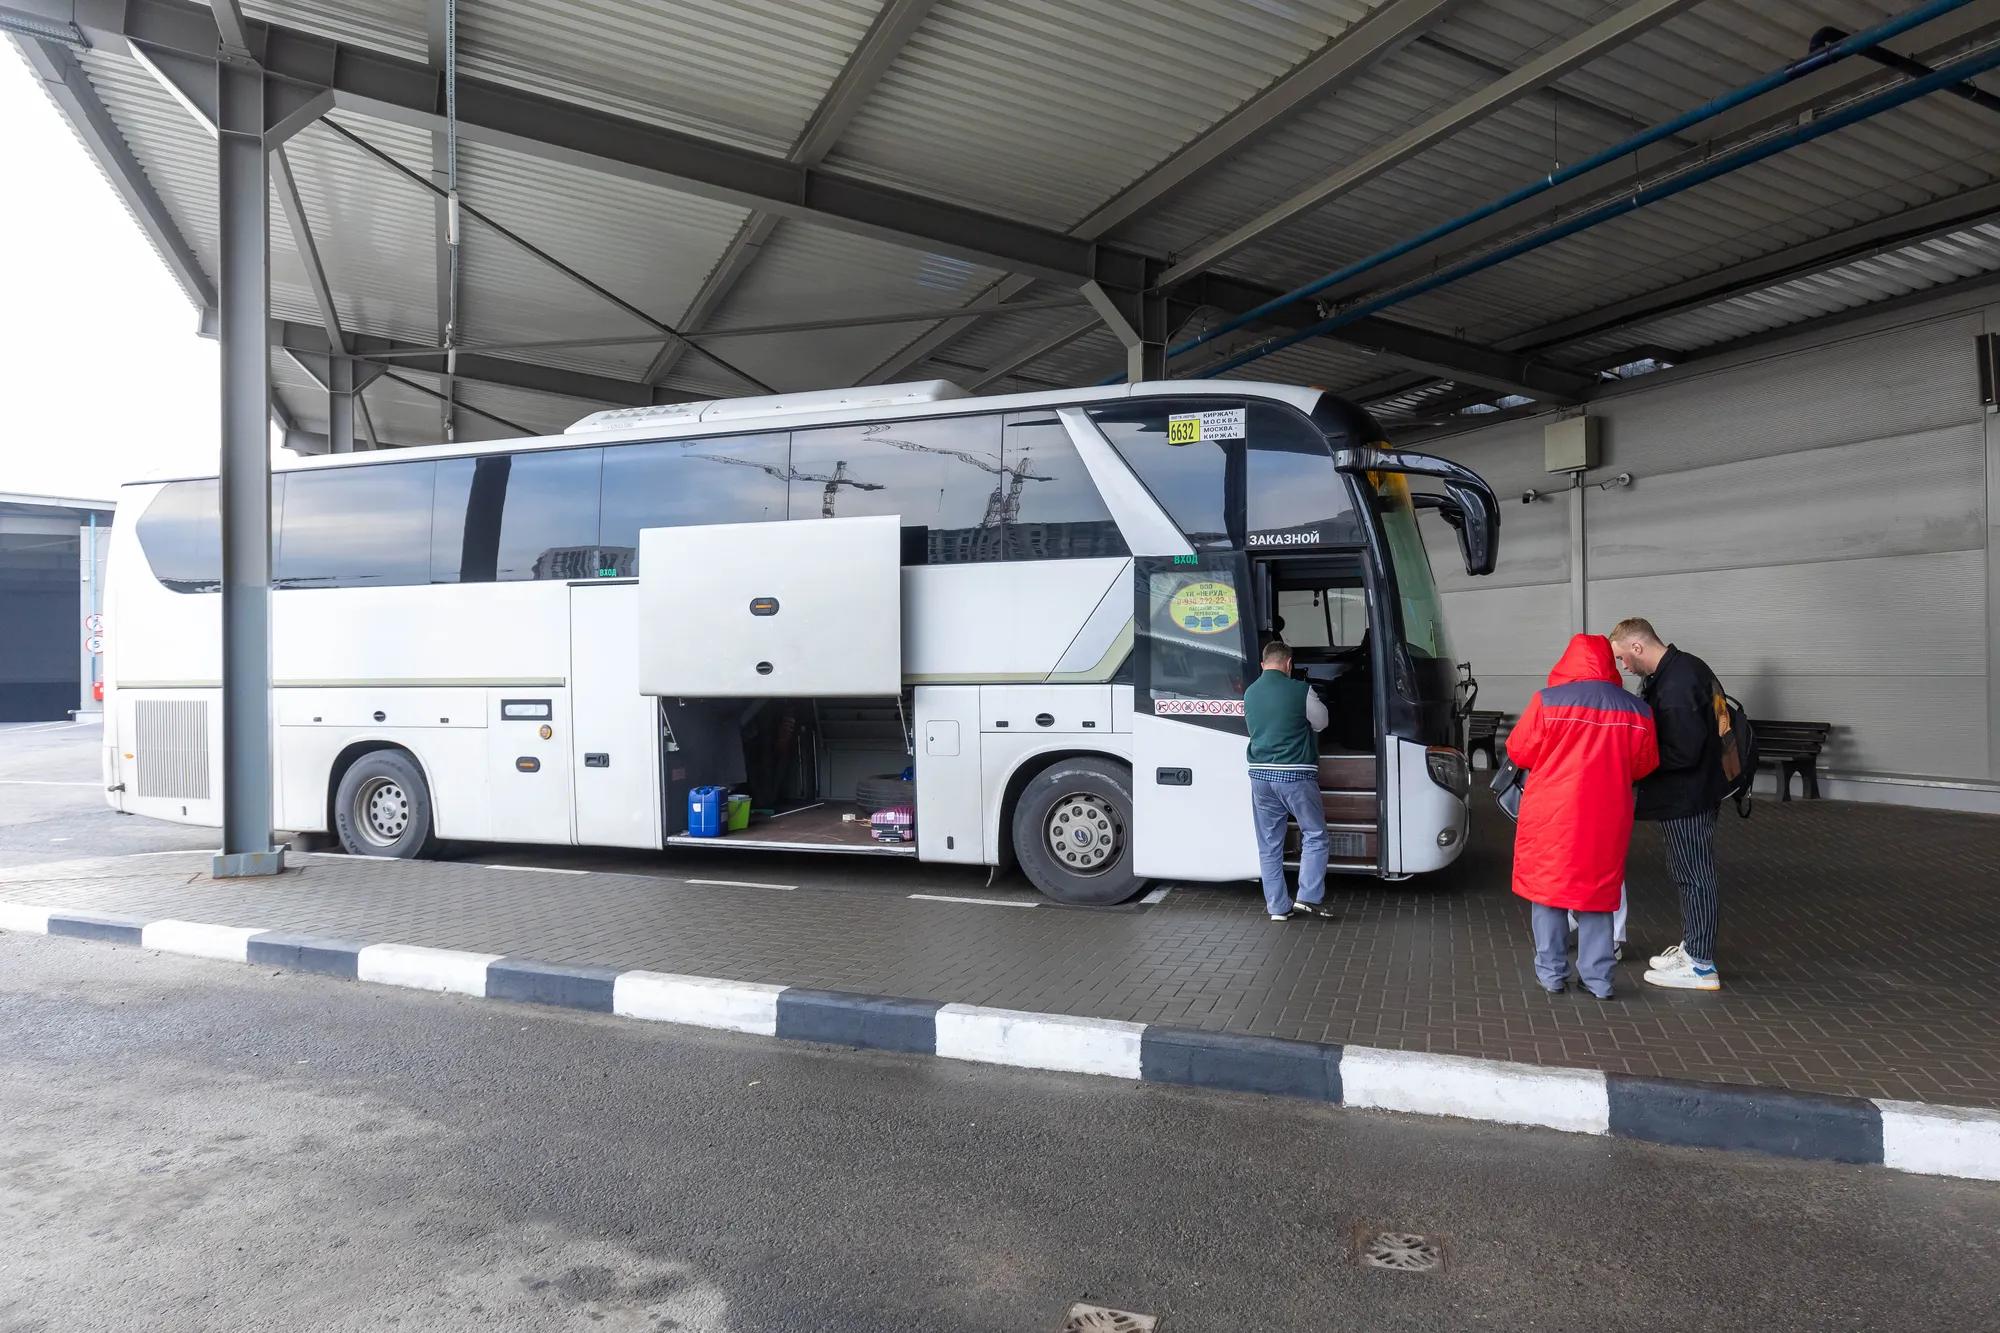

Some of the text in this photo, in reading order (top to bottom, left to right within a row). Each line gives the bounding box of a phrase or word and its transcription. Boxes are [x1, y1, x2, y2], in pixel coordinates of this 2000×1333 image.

[1203, 417, 1239, 425] МОСКВА
[1171, 422, 1194, 441] 6632
[1203, 425, 1233, 433] МОСКВА
[1203, 432, 1238, 440] КИРЖАЧ
[1249, 530, 1320, 546] ЗАКАЗНОЙ
[1174, 555, 1198, 565] ВХОД
[600, 568, 616, 577] ВХОД
